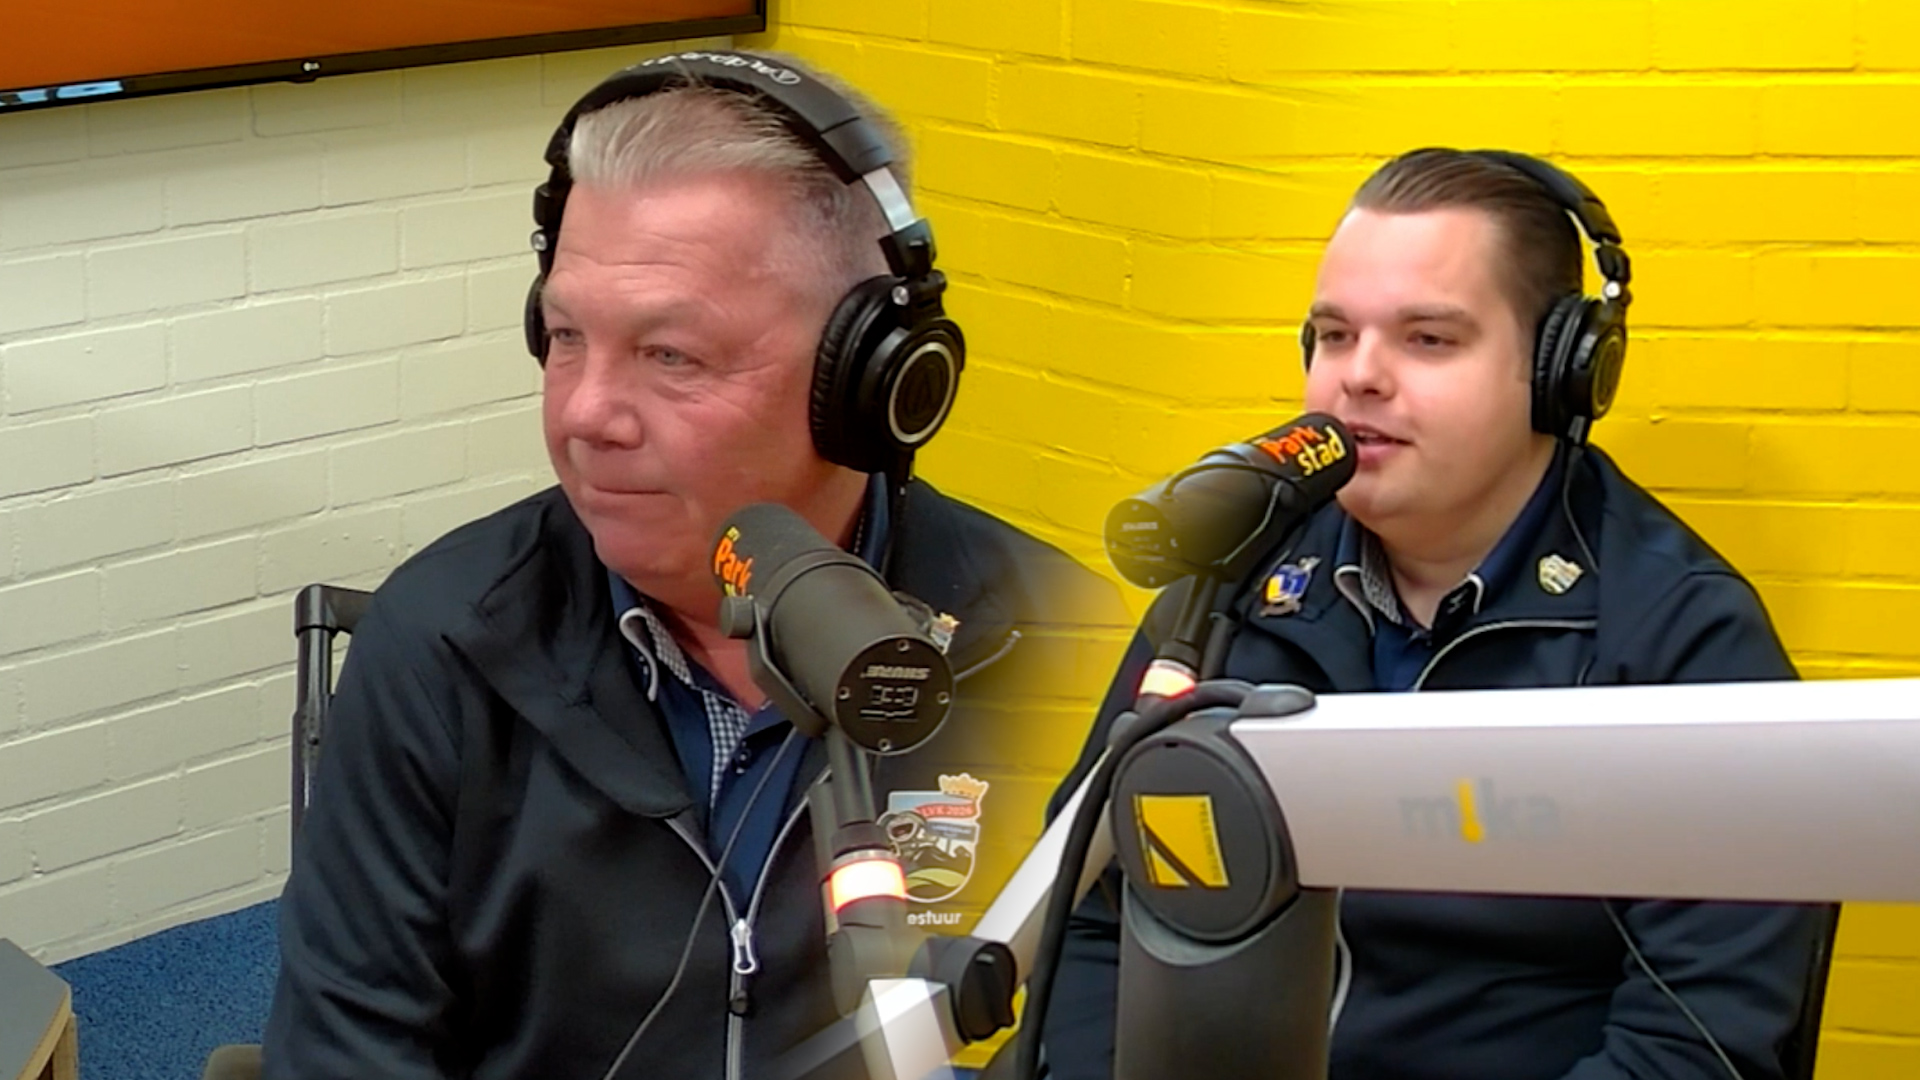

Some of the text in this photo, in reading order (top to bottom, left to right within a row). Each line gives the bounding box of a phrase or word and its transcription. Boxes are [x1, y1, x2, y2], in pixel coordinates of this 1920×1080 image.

[1261, 426, 1324, 464] Park
[1297, 425, 1346, 476] stad
[714, 536, 754, 596] Park
[906, 910, 962, 924] estuur
